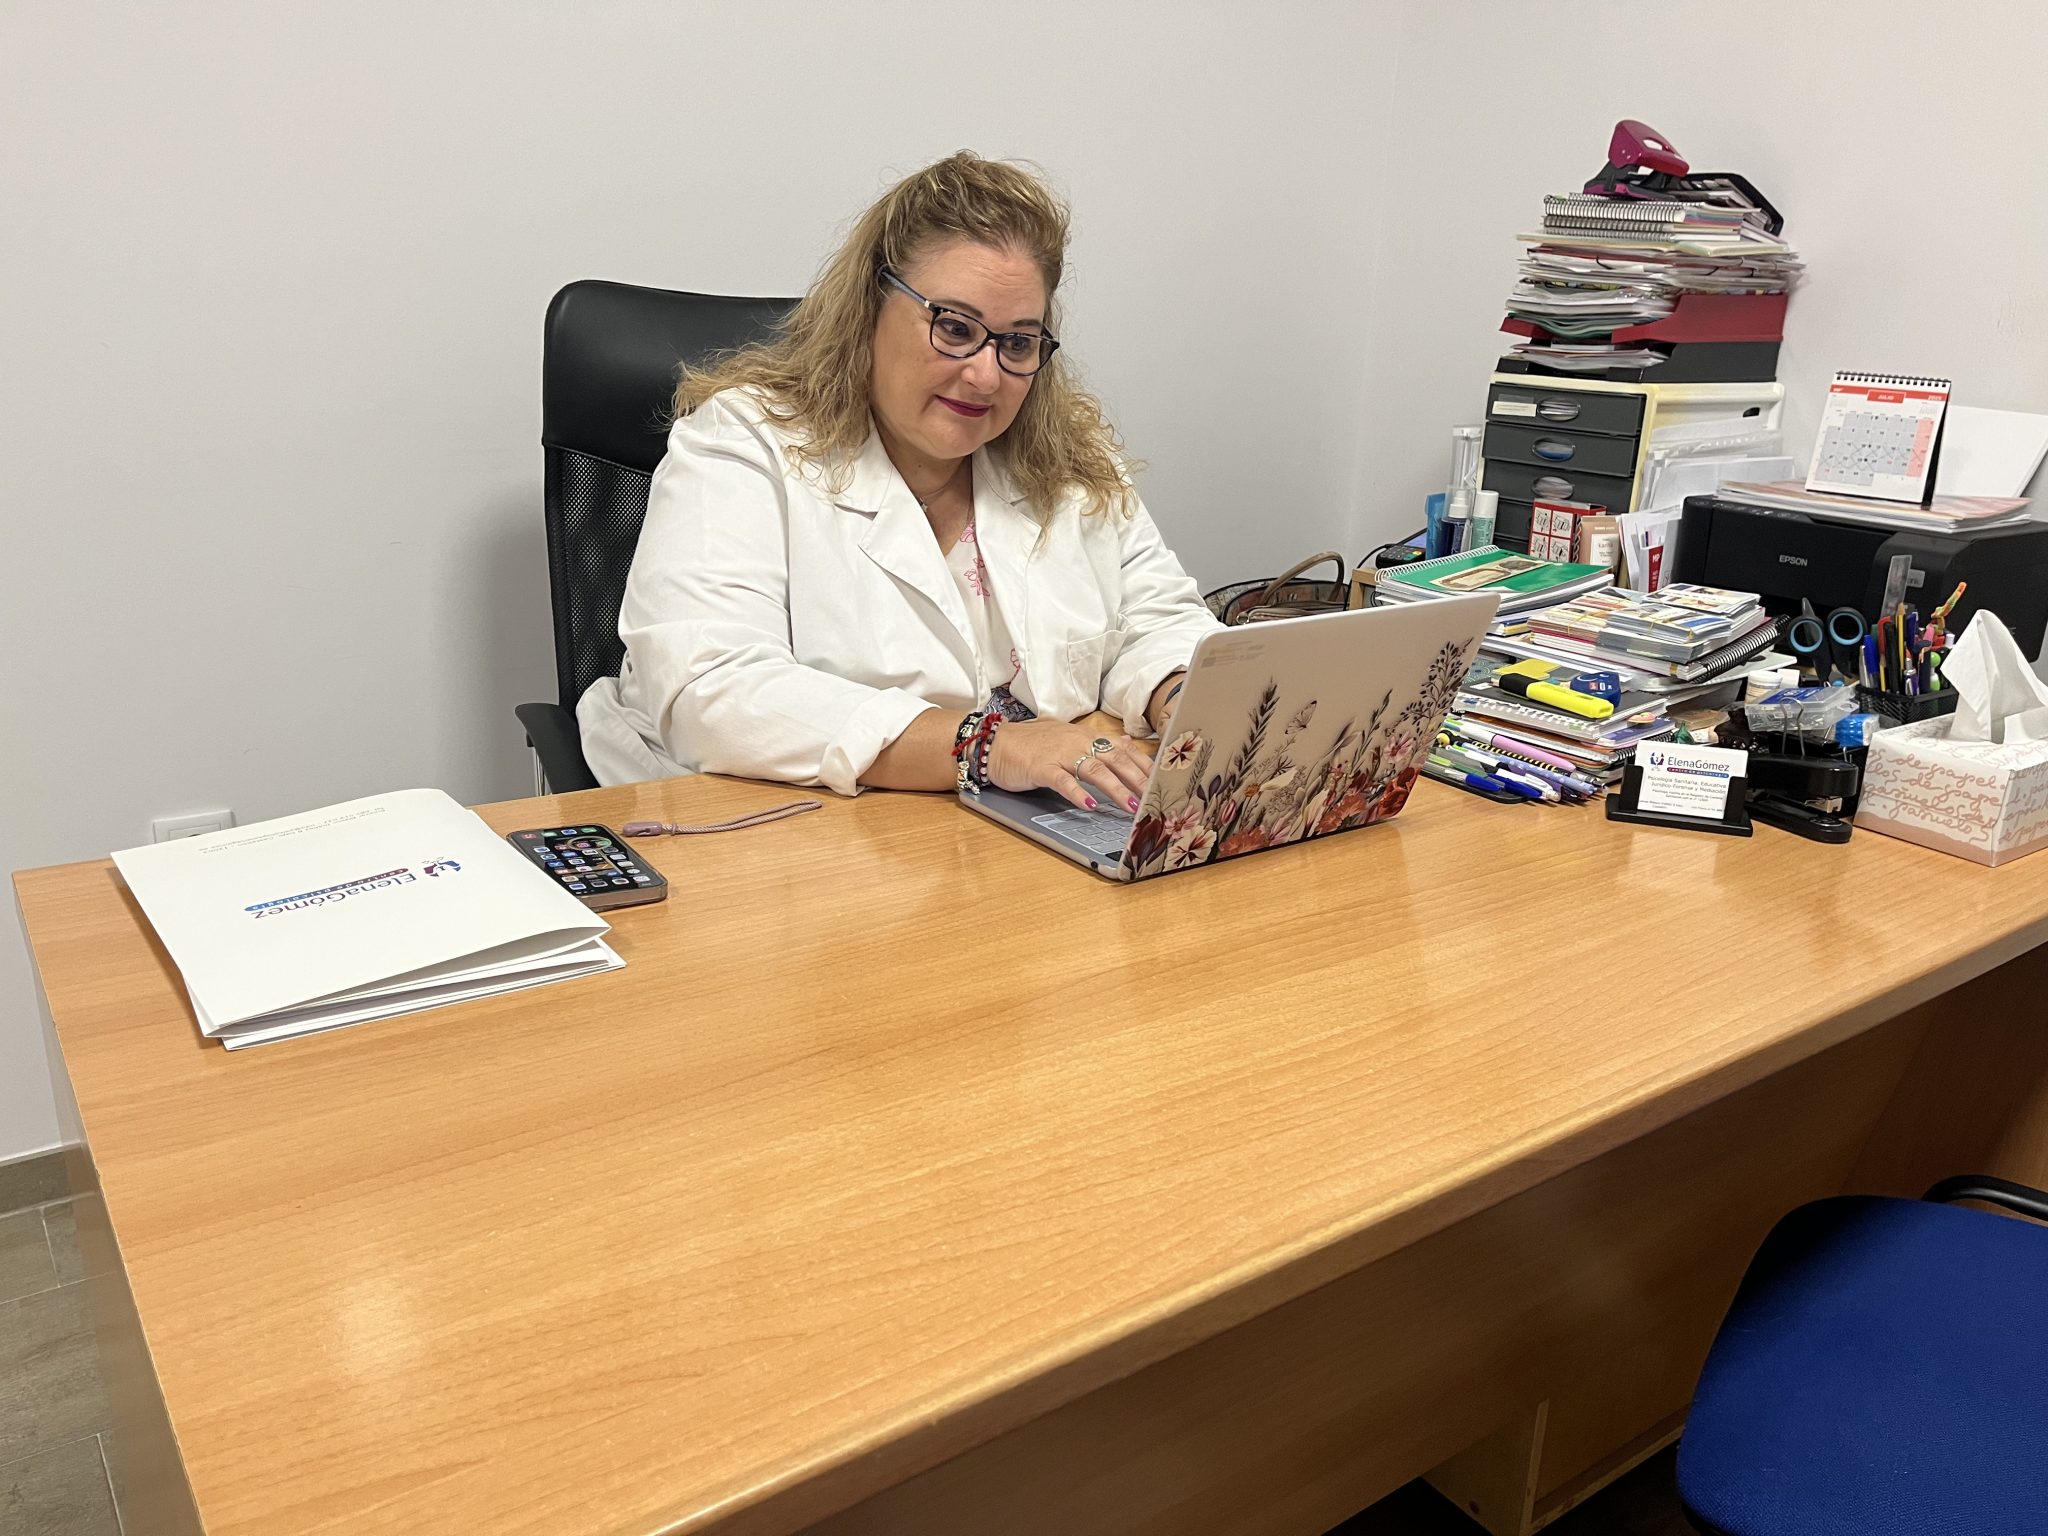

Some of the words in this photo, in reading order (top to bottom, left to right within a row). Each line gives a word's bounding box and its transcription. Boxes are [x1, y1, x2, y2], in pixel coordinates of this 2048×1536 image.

[1779, 554, 1808, 567] EPSON
[1668, 756, 1730, 772] ElenaGómez
[250, 873, 417, 919] ElenaGómez
